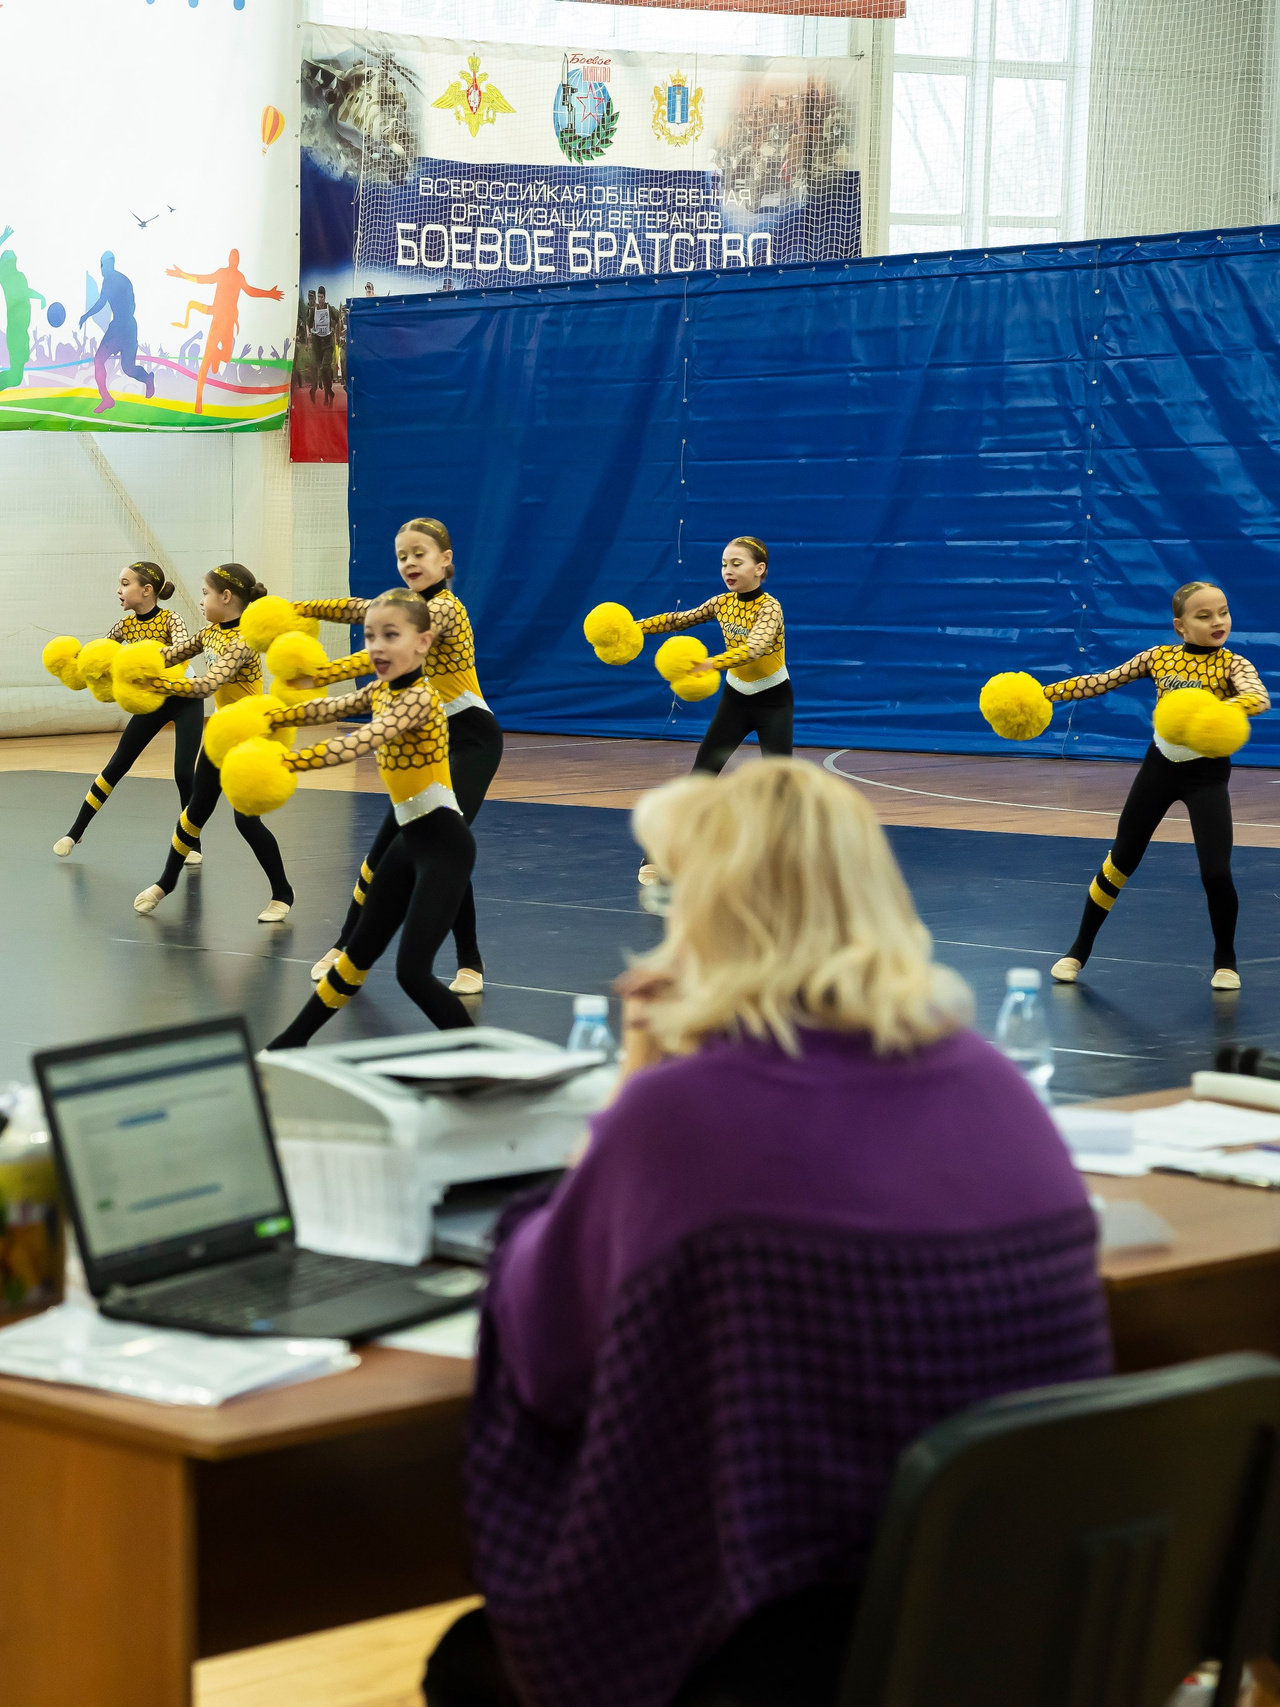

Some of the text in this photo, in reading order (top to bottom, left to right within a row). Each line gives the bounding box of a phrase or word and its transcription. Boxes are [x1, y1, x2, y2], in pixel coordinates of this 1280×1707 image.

[570, 53, 611, 65] Боевое
[420, 177, 752, 208] ВСЕРОССИЙКАЯ ОБЩЕСТВЕННАЯ
[451, 203, 721, 230] ОРГАНИЗАЦИЯ ВЕТЕРАНОВ
[396, 222, 772, 274] БОЕВОЕ БРАТСТВО
